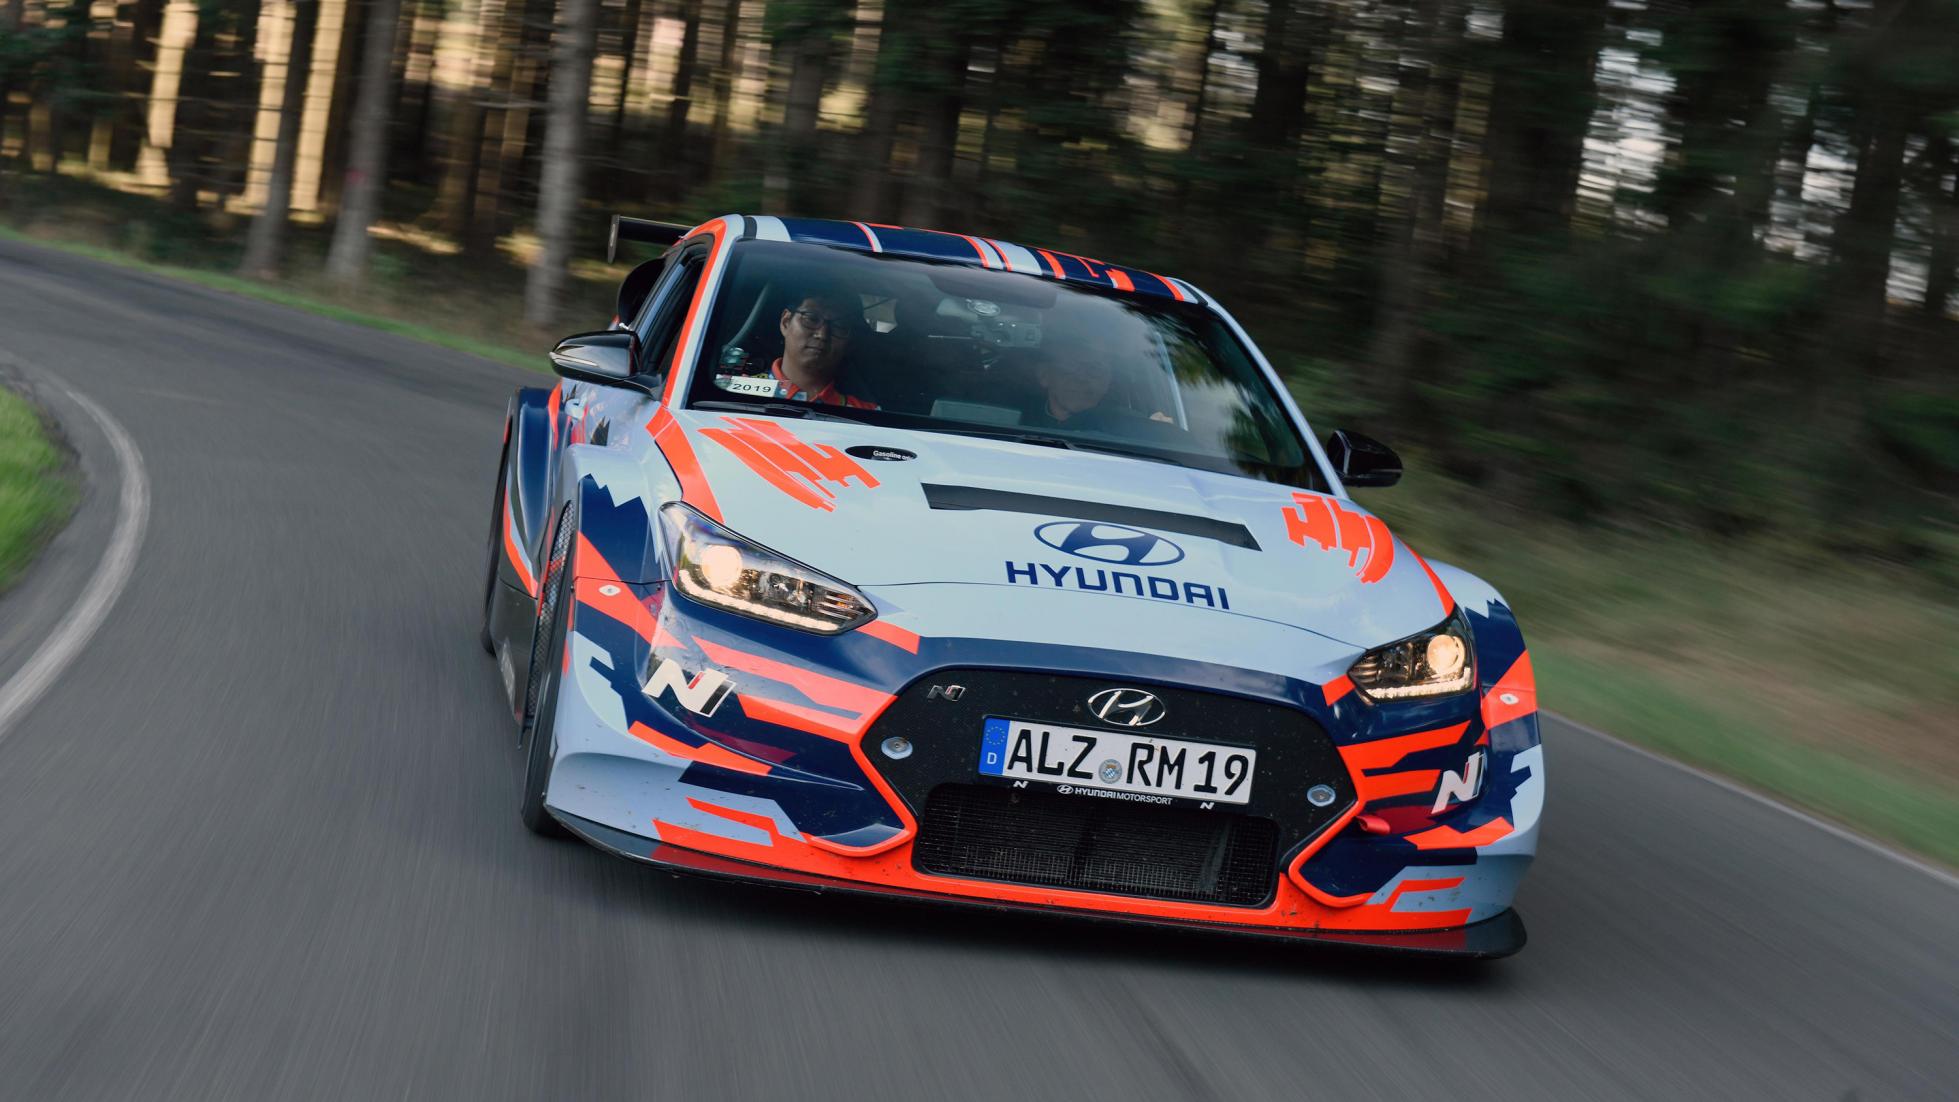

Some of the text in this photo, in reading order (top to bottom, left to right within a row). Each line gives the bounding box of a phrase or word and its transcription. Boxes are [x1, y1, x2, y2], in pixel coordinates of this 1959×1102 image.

[732, 383, 771, 393] 2019
[872, 450, 902, 459] Gasoline
[1005, 561, 1230, 609] HYUNDAI
[987, 752, 997, 765] D
[1007, 729, 1249, 796] ALZ RM 19
